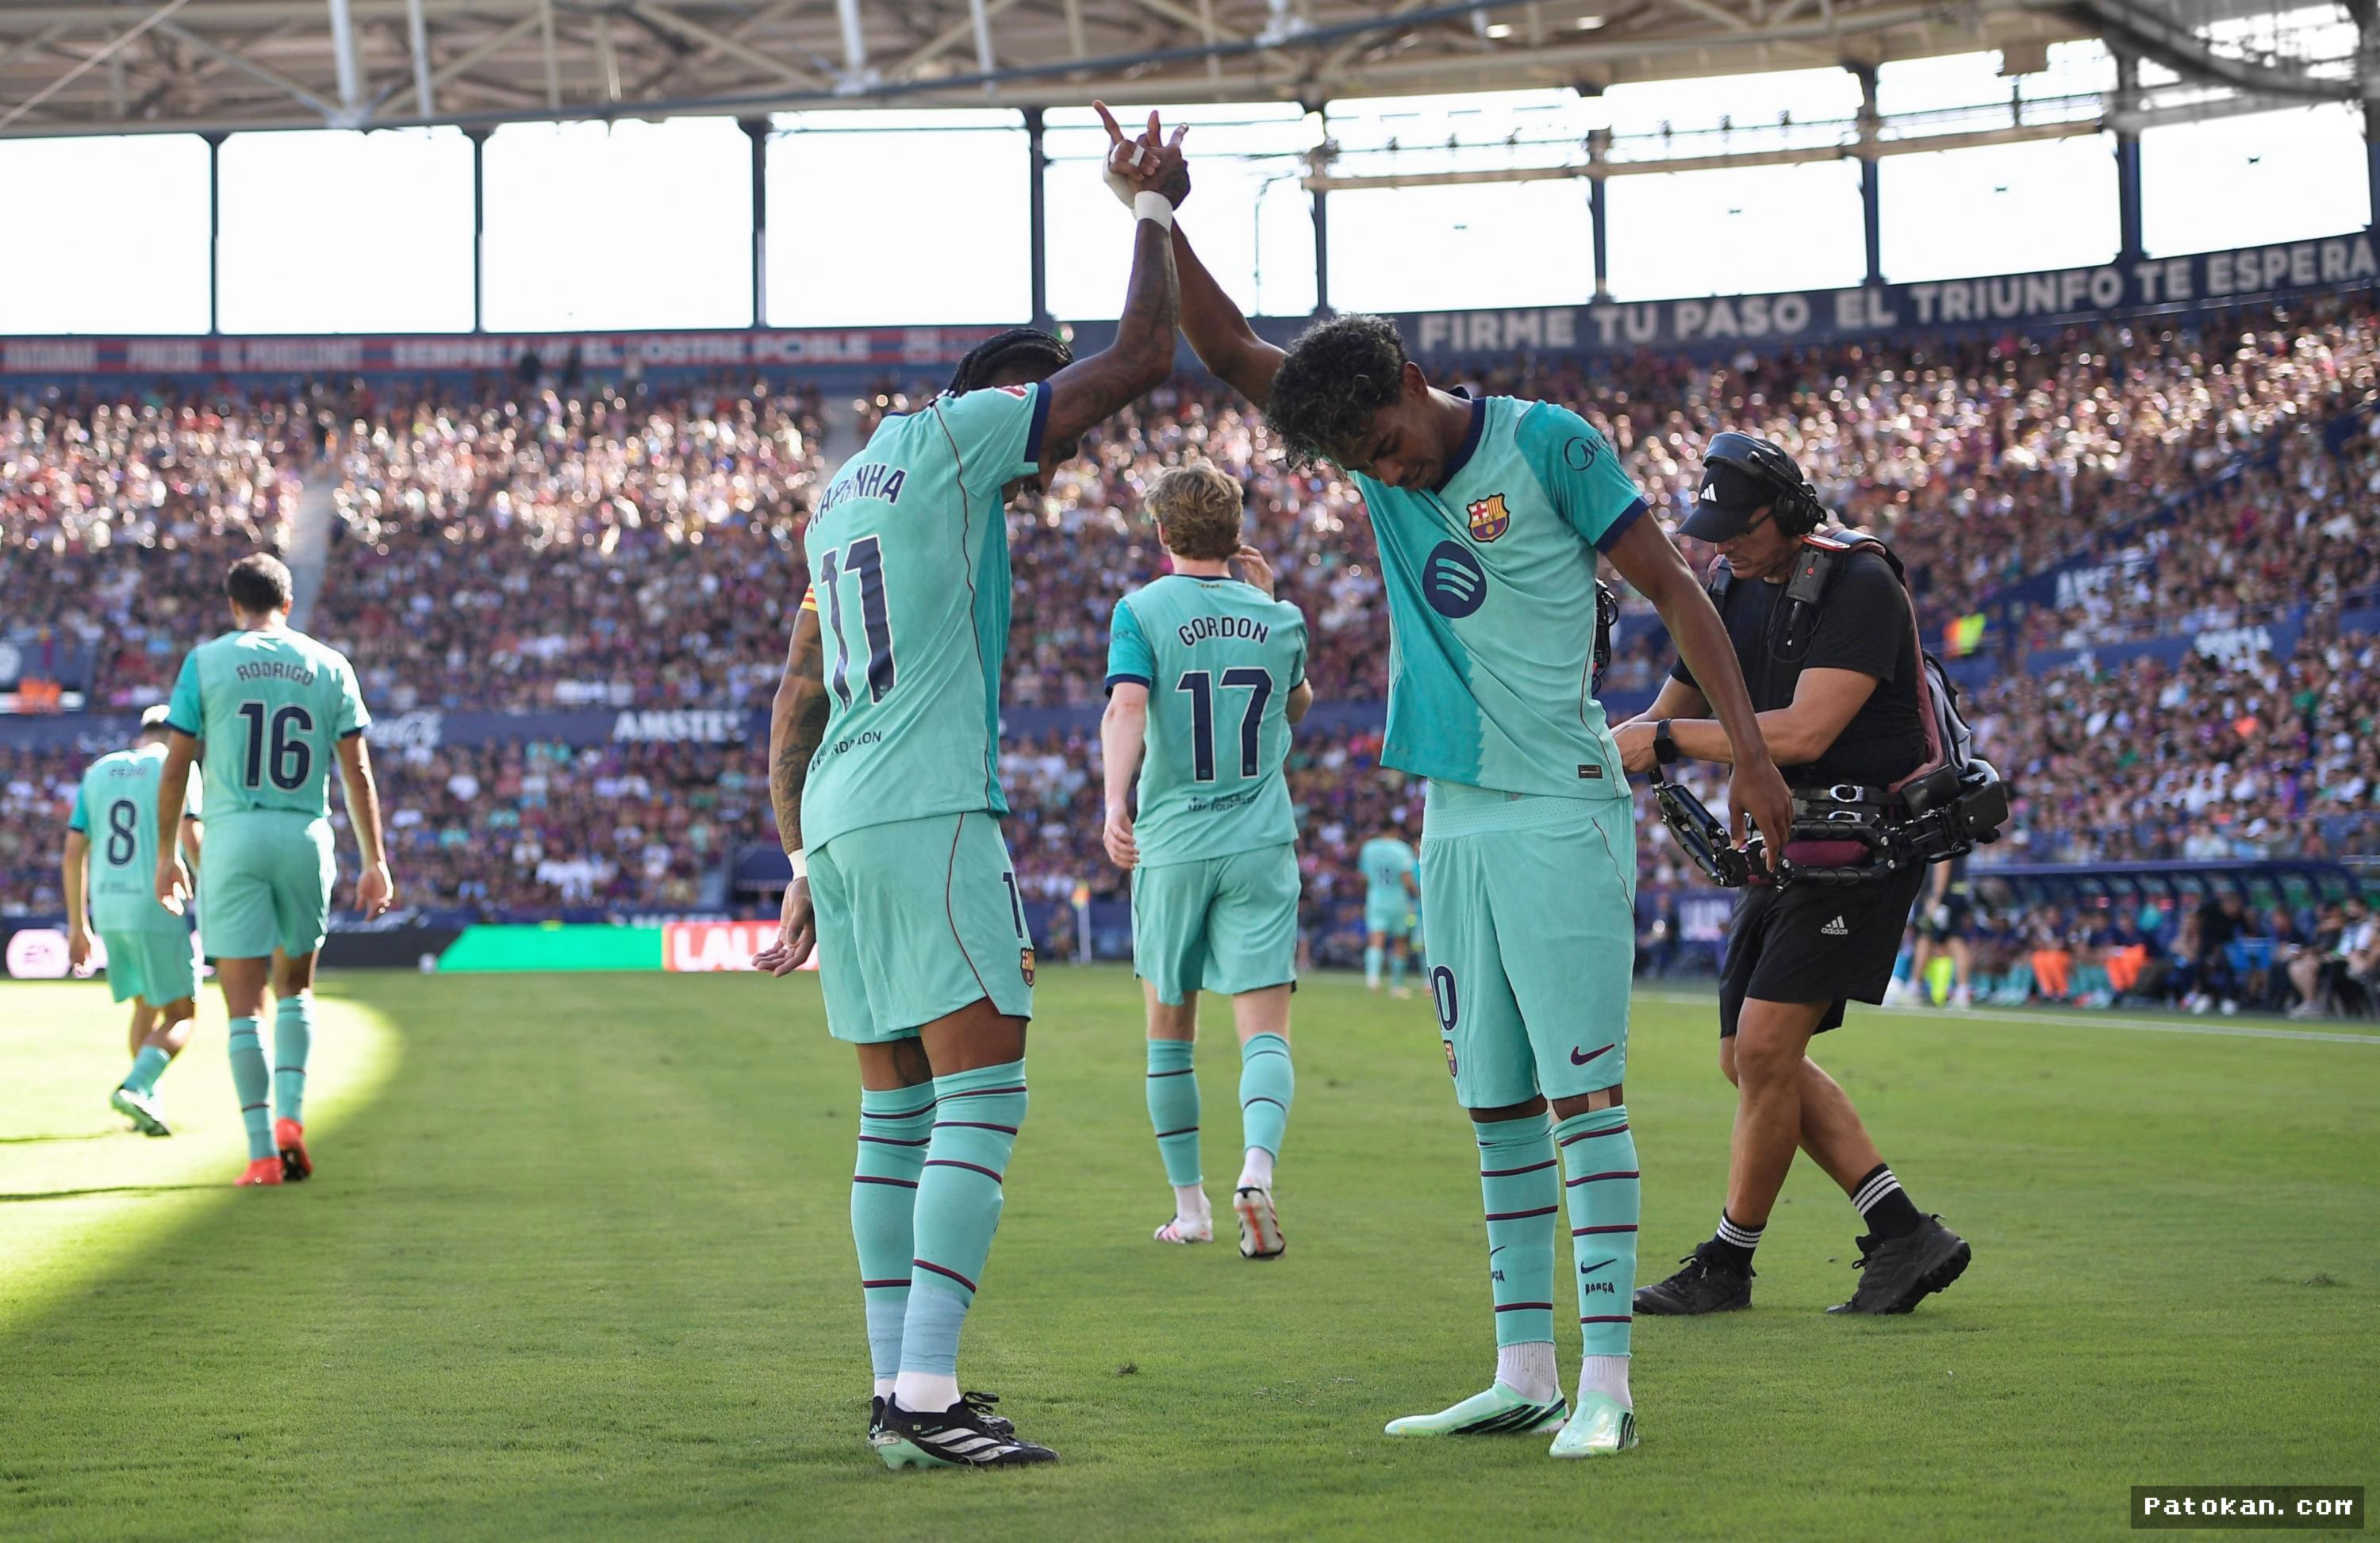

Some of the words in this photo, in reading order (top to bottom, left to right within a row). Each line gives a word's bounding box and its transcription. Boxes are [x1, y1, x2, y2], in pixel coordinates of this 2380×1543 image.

[1418, 308, 1576, 351] FIRME
[1593, 302, 1658, 344] TU
[1674, 291, 1810, 340] PASO
[1834, 288, 1896, 329] EL
[1910, 267, 2125, 323] TRIUNFO
[2134, 258, 2194, 302] TE
[2206, 237, 2377, 295] ESPERA
[752, 328, 871, 363] POBLE
[820, 534, 896, 714] 11
[1178, 616, 1269, 647] GORDON
[236, 660, 315, 686] RODRIGO
[236, 699, 315, 793] 16
[1175, 666, 1274, 784] 17
[106, 798, 137, 868] 8
[1585, 1281, 1615, 1295] BARÇA
